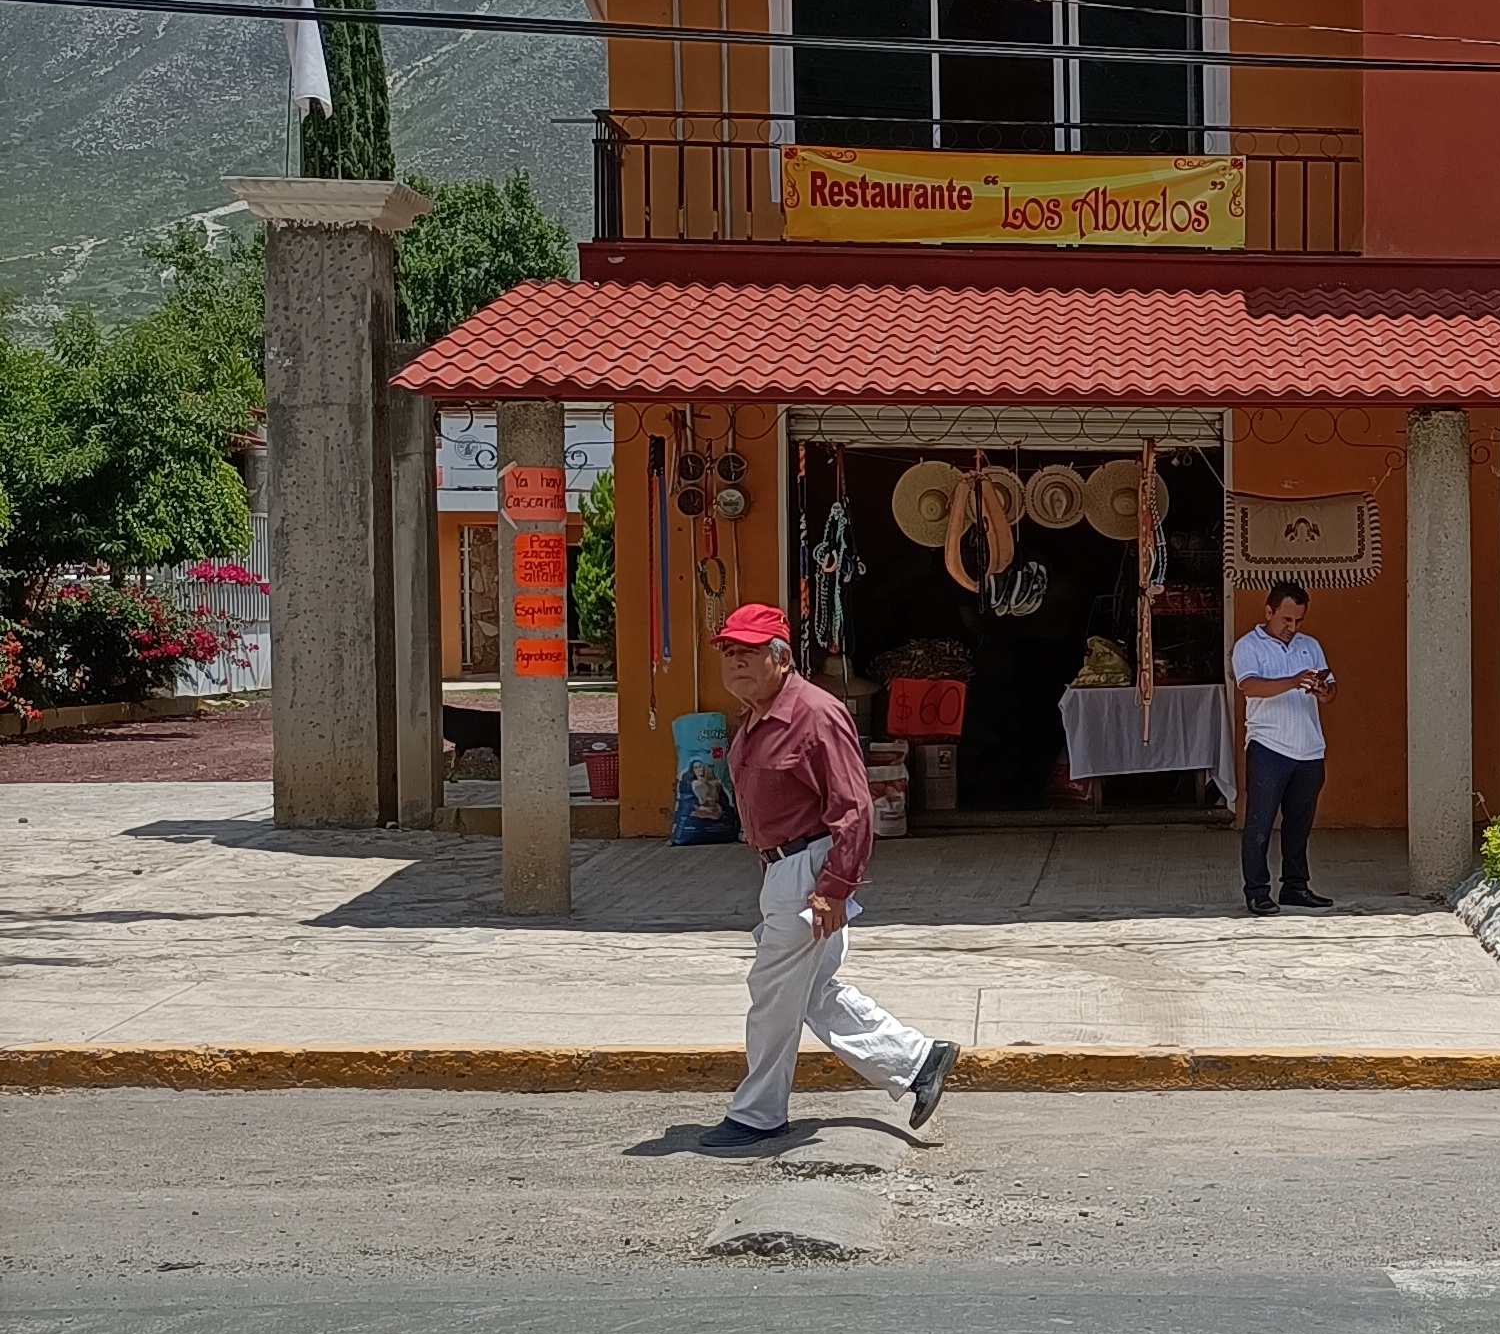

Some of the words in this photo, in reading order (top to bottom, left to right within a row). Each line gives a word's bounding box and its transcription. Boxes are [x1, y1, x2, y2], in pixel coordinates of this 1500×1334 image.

[810, 171, 973, 211] Restaurante
[510, 470, 529, 489] Ya
[540, 471, 562, 494] hay
[513, 599, 563, 625] Esquilmo
